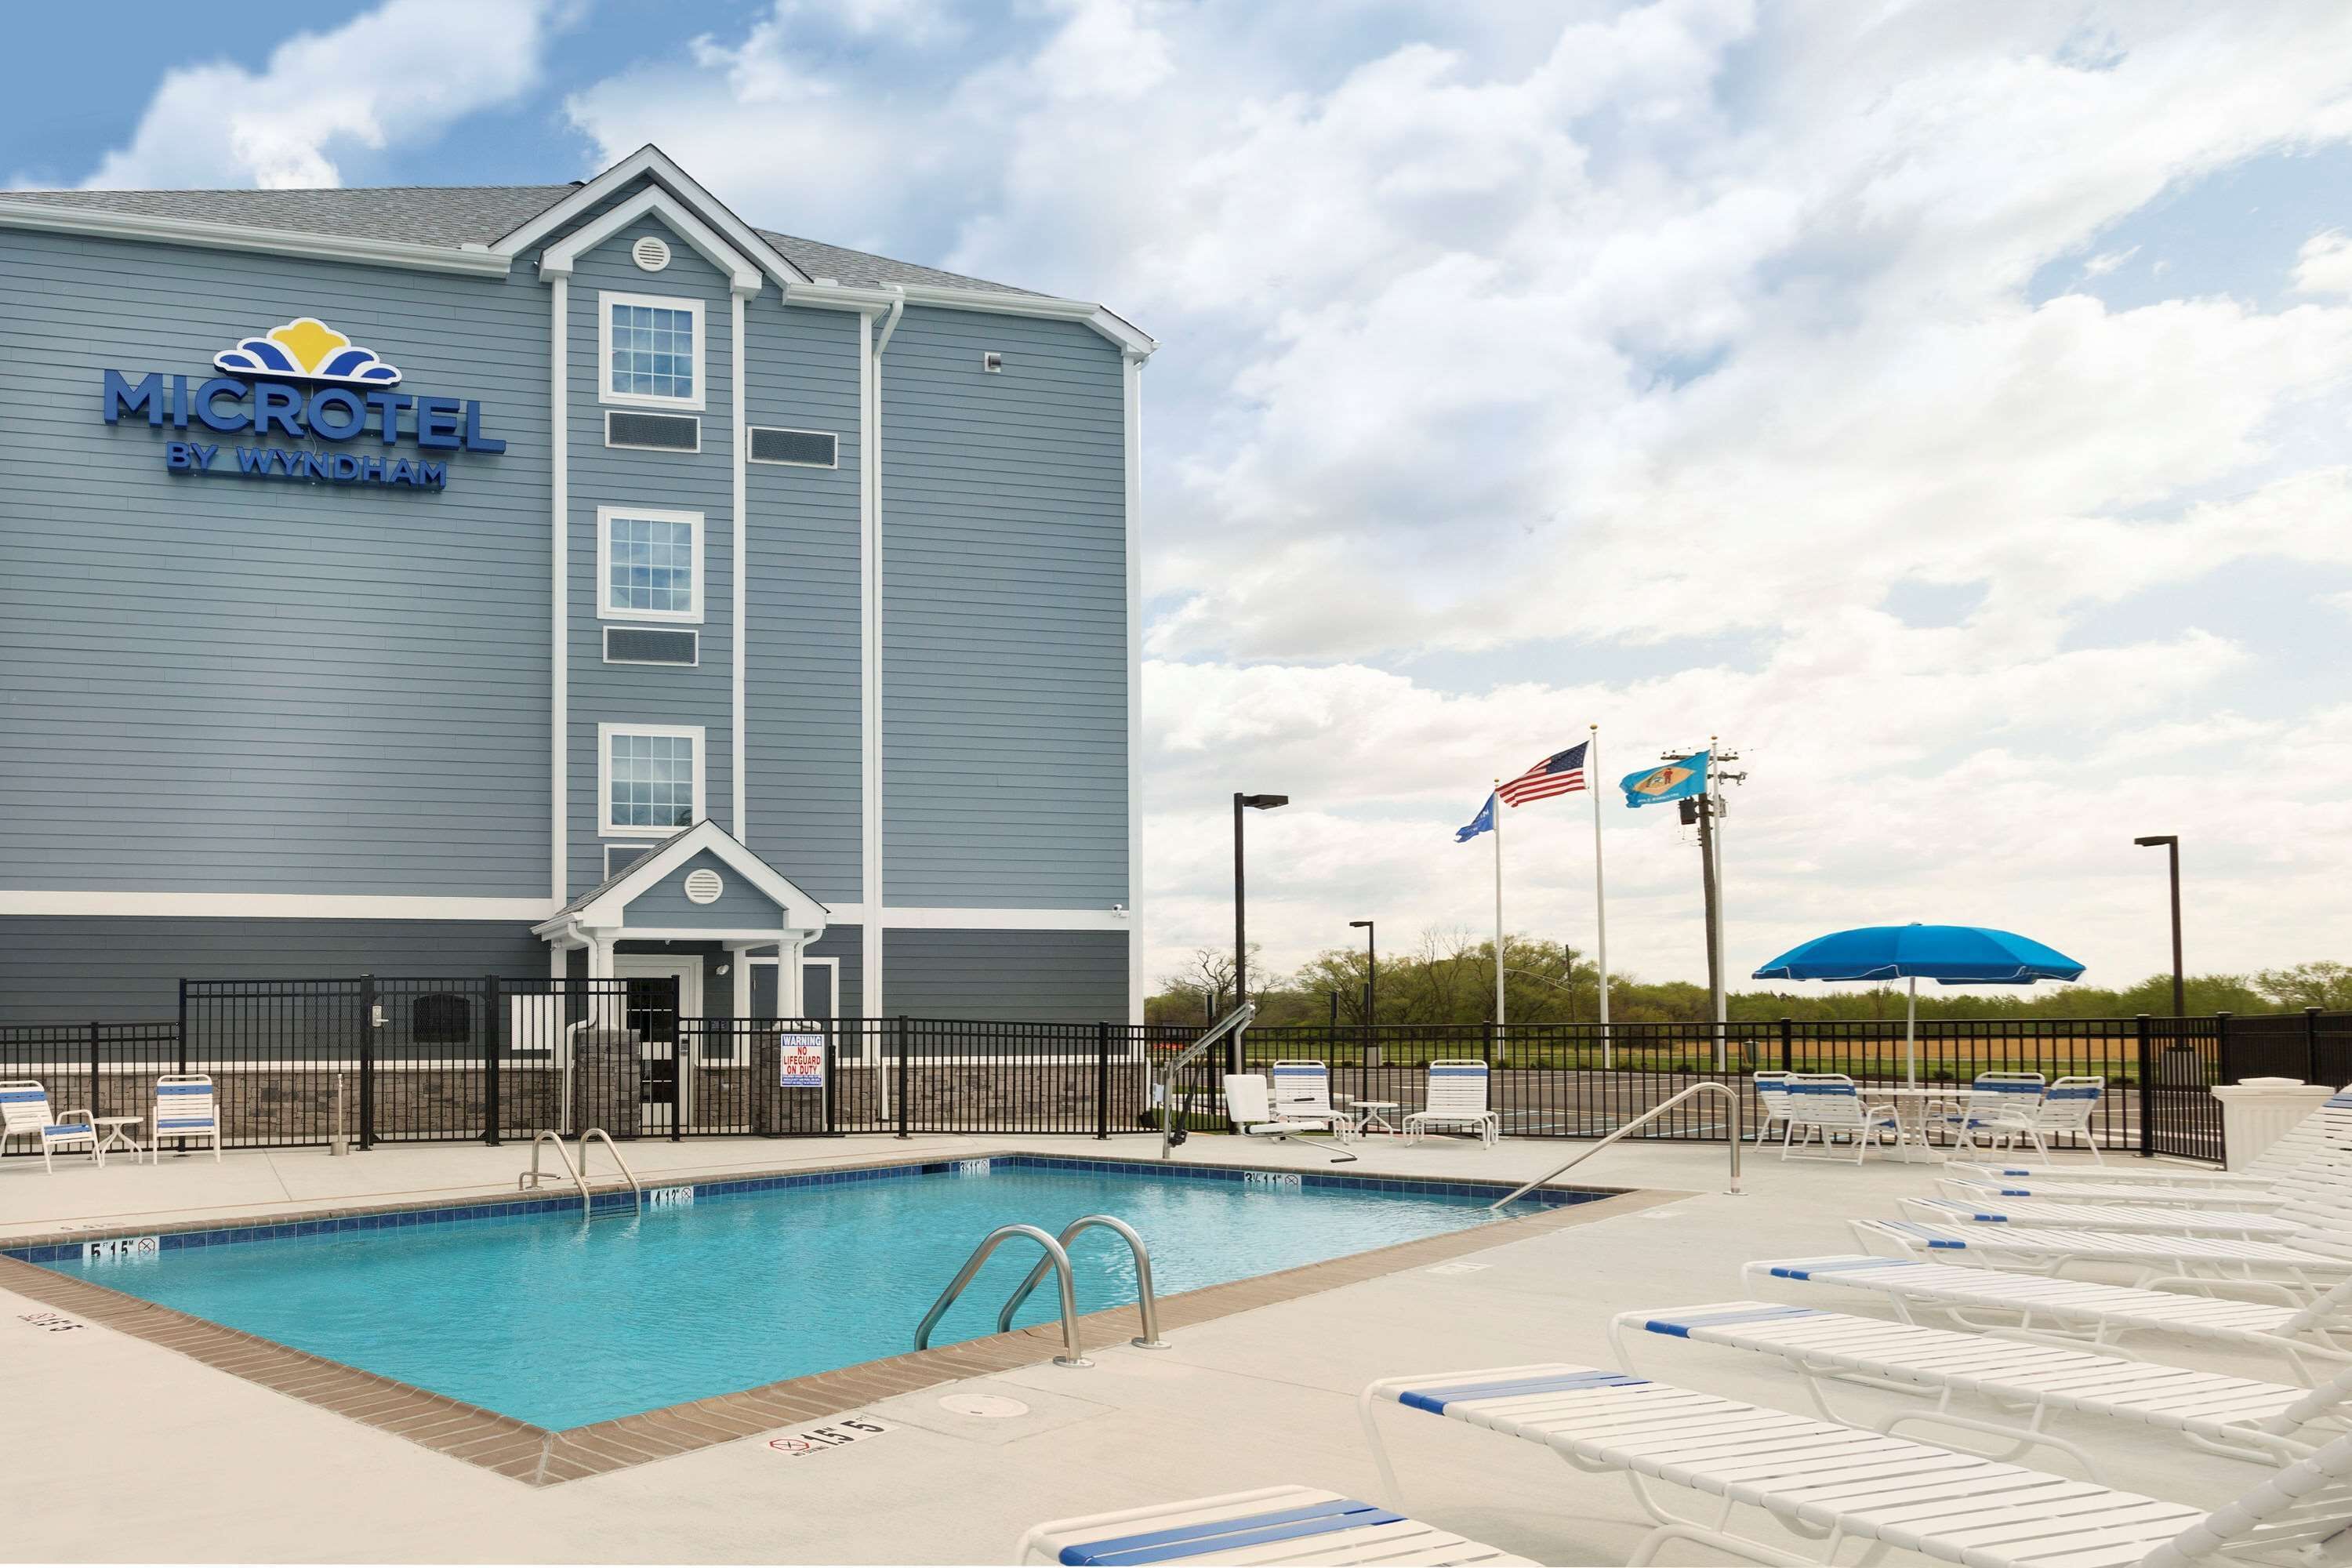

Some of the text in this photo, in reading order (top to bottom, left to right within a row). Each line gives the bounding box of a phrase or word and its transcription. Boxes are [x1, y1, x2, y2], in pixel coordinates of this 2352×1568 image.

[103, 369, 506, 454] MICROTEL
[166, 441, 448, 490] BY WYNDHAM
[783, 1036, 822, 1046] WARNING
[797, 1047, 808, 1055] NO
[783, 1056, 821, 1065] LIFEGUARD
[786, 1065, 817, 1074] ON DUTY
[840, 1420, 885, 1432] 5
